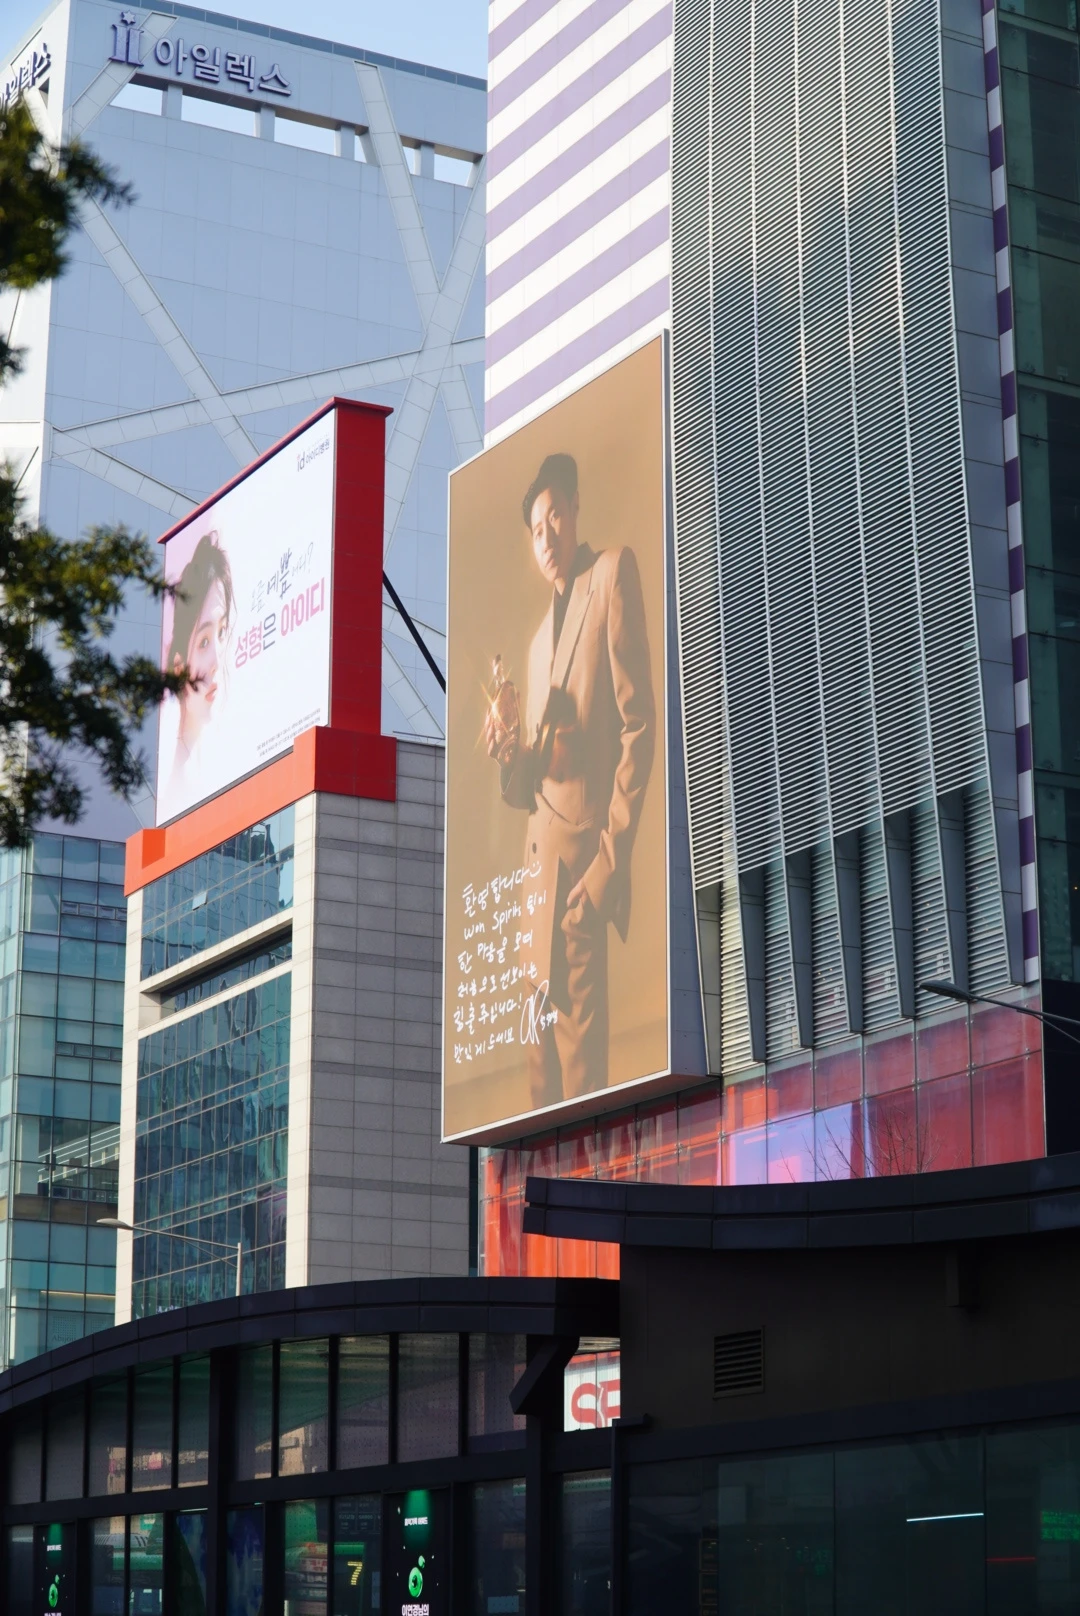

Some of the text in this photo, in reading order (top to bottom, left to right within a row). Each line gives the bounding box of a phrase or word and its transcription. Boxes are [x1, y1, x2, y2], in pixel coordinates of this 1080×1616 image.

[155, 38, 292, 96] 아일렉스
[234, 577, 324, 669] 성형은 아이디
[462, 866, 530, 918] 환영합니다
[457, 950, 473, 974] 한
[477, 936, 508, 963] 마음을
[457, 961, 538, 998] 처음으로 선보이는
[487, 1027, 515, 1051] 드세요
[347, 1561, 363, 1586] 7
